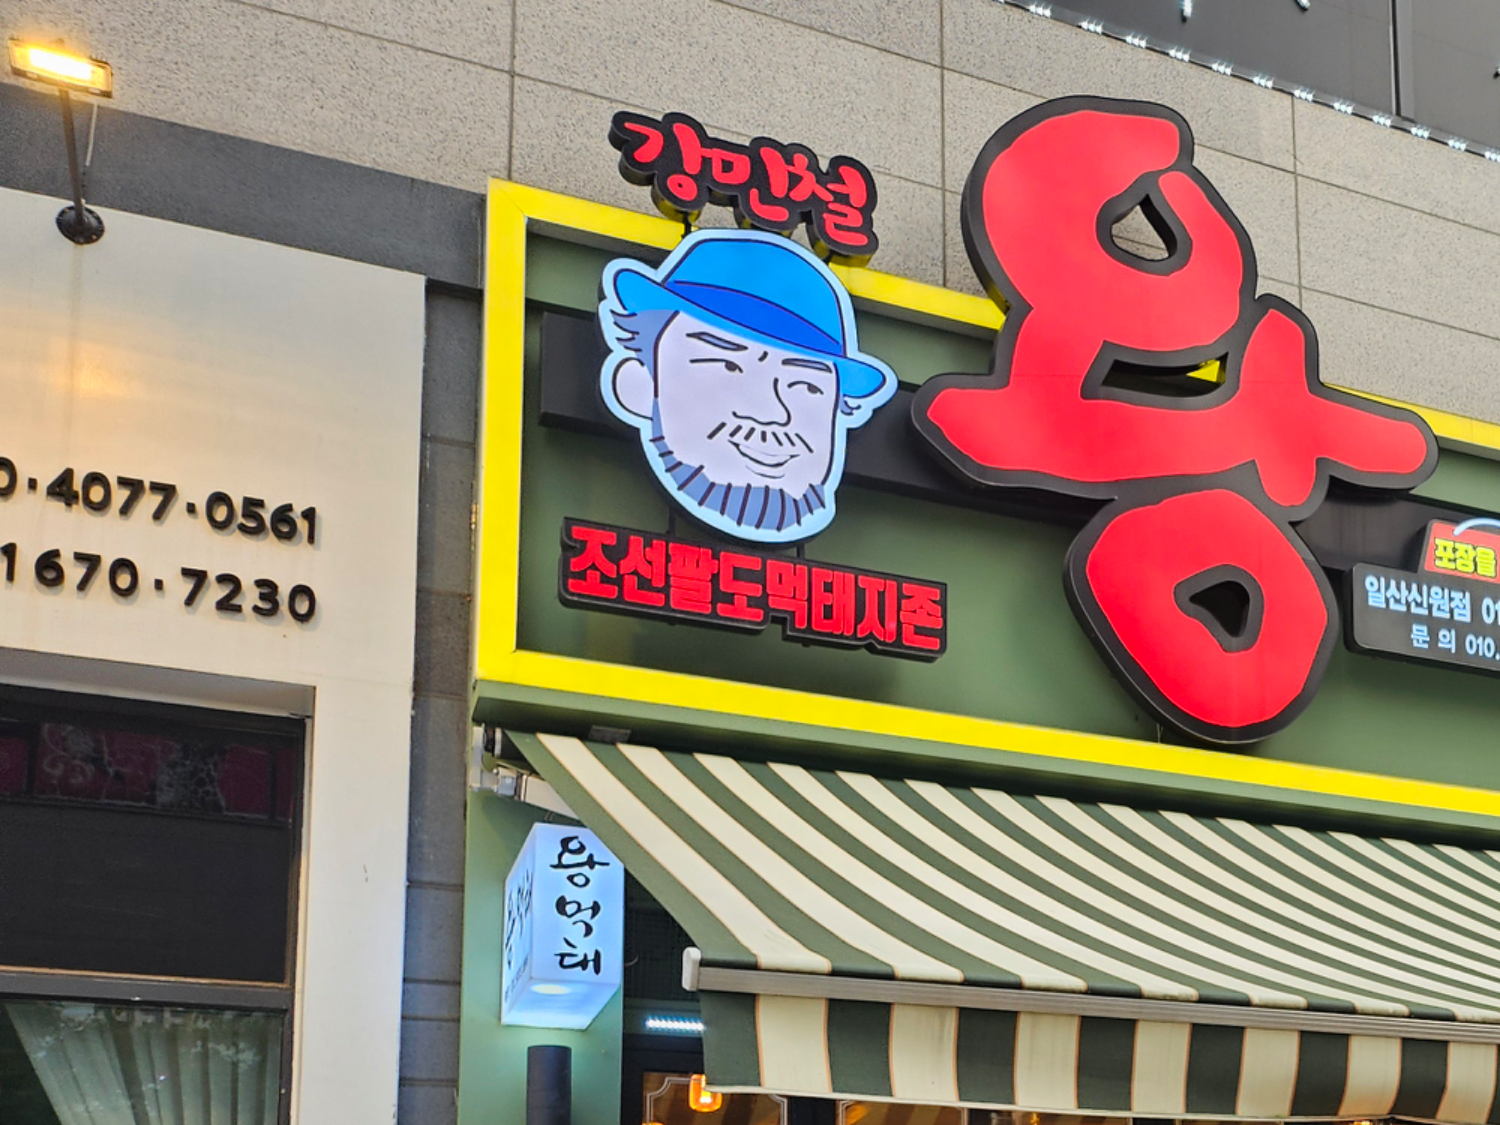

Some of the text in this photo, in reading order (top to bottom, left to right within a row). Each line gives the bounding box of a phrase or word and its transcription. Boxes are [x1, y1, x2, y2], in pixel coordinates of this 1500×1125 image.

[925, 108, 1430, 730] 왕
[1365, 574, 1471, 622] 일산신원점
[1434, 538, 1496, 578] 포장을
[550, 836, 610, 975] 왕먹태
